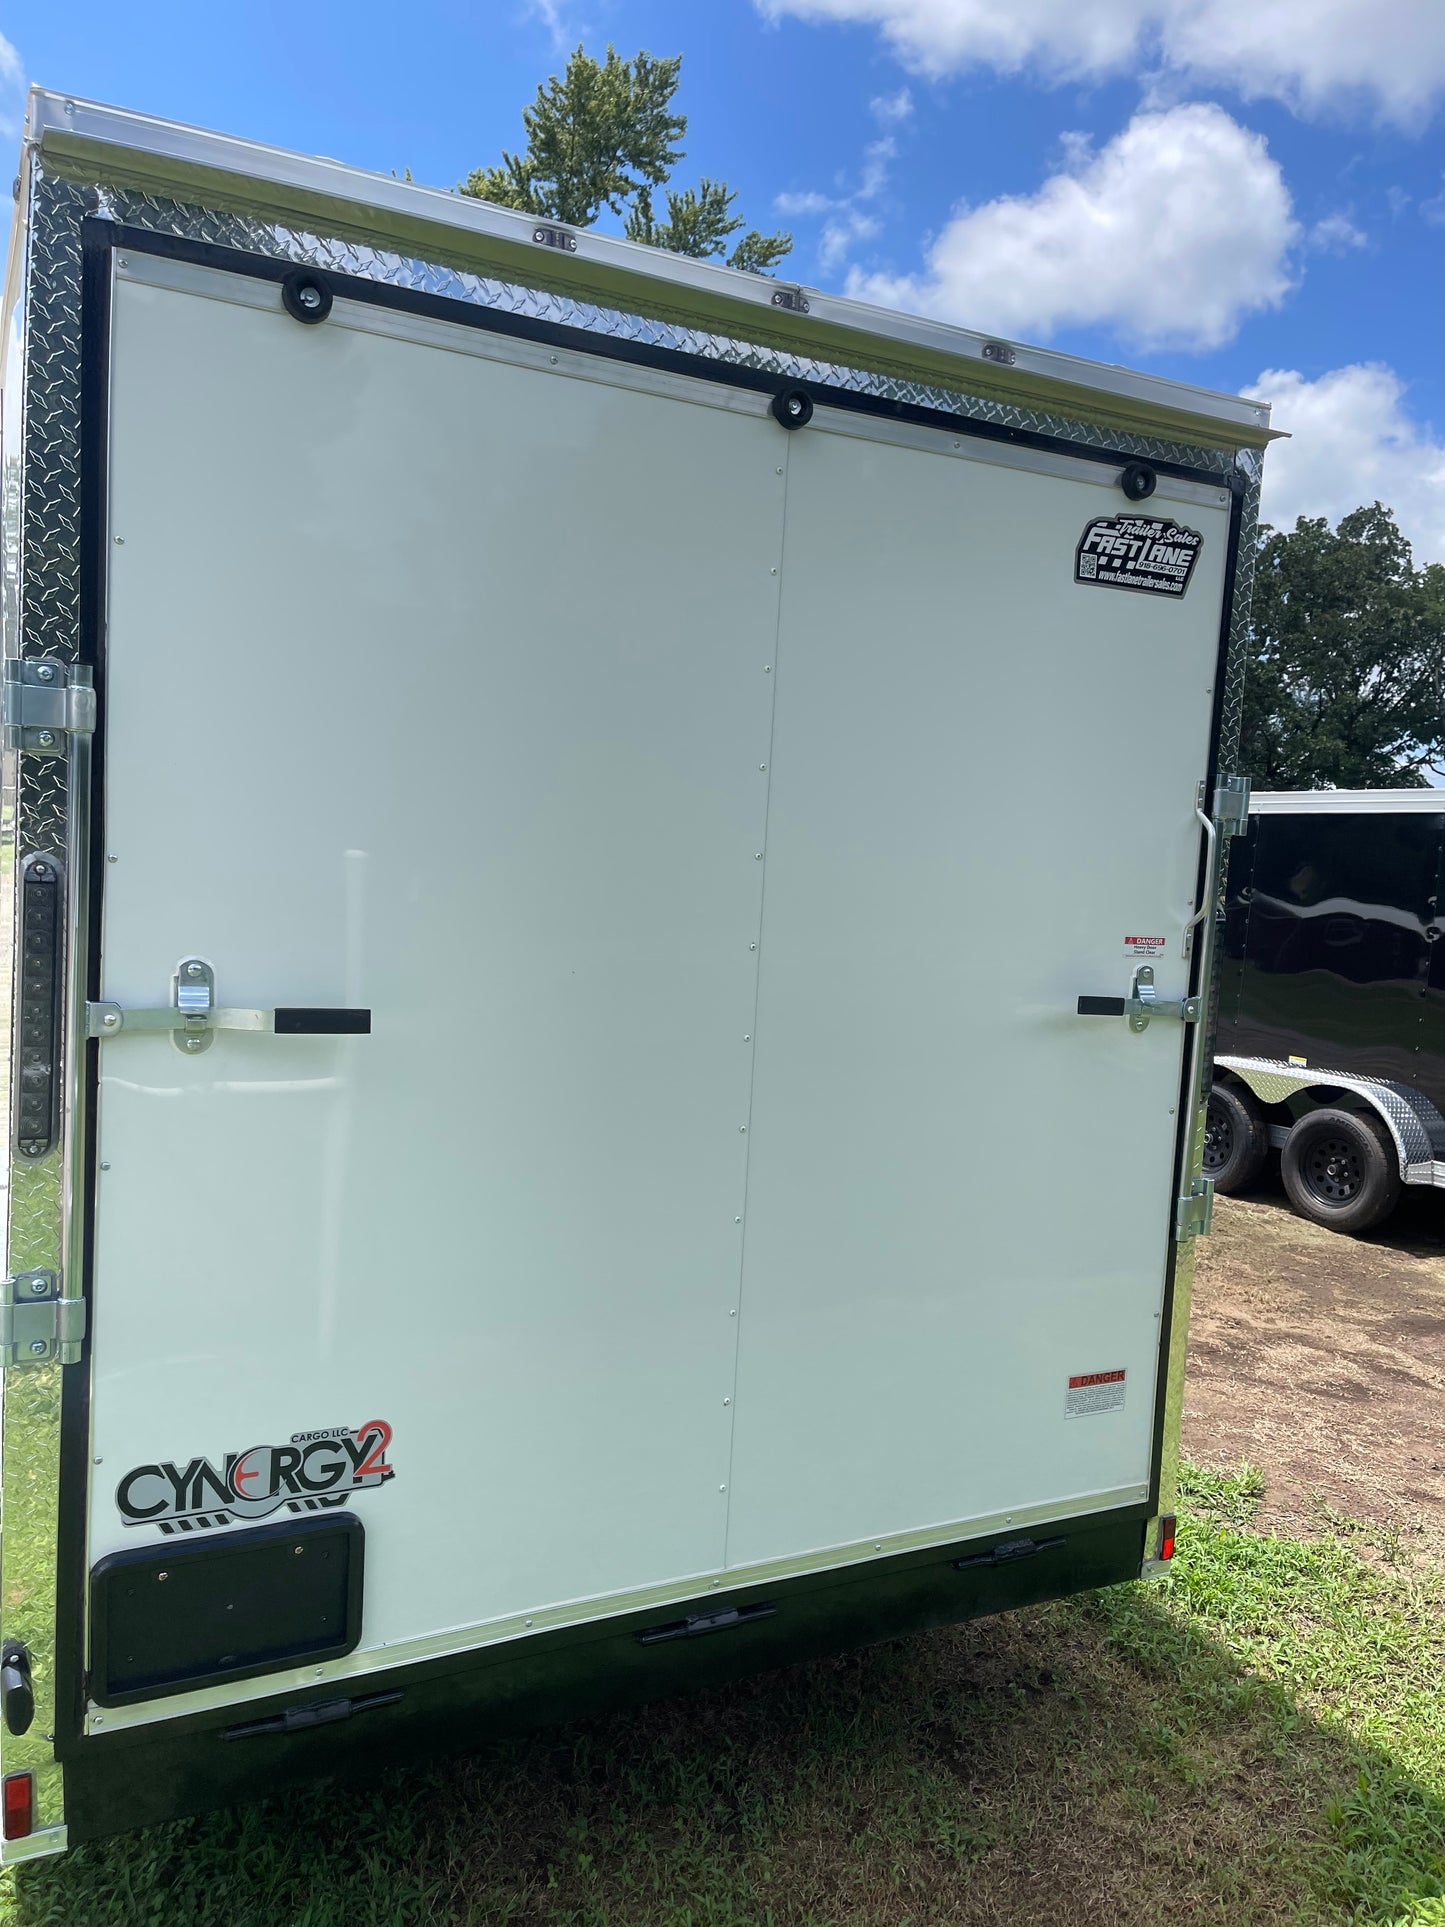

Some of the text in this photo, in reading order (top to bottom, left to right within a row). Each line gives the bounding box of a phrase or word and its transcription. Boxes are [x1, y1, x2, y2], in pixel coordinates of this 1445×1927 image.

[1119, 519, 1200, 546] Trailer Sales
[1098, 570, 1183, 592] www.fastlanetrailersales.com
[1136, 937, 1163, 945] DANGER
[1081, 1371, 1124, 1386] DANGER
[291, 1428, 349, 1443] CARGO LLC
